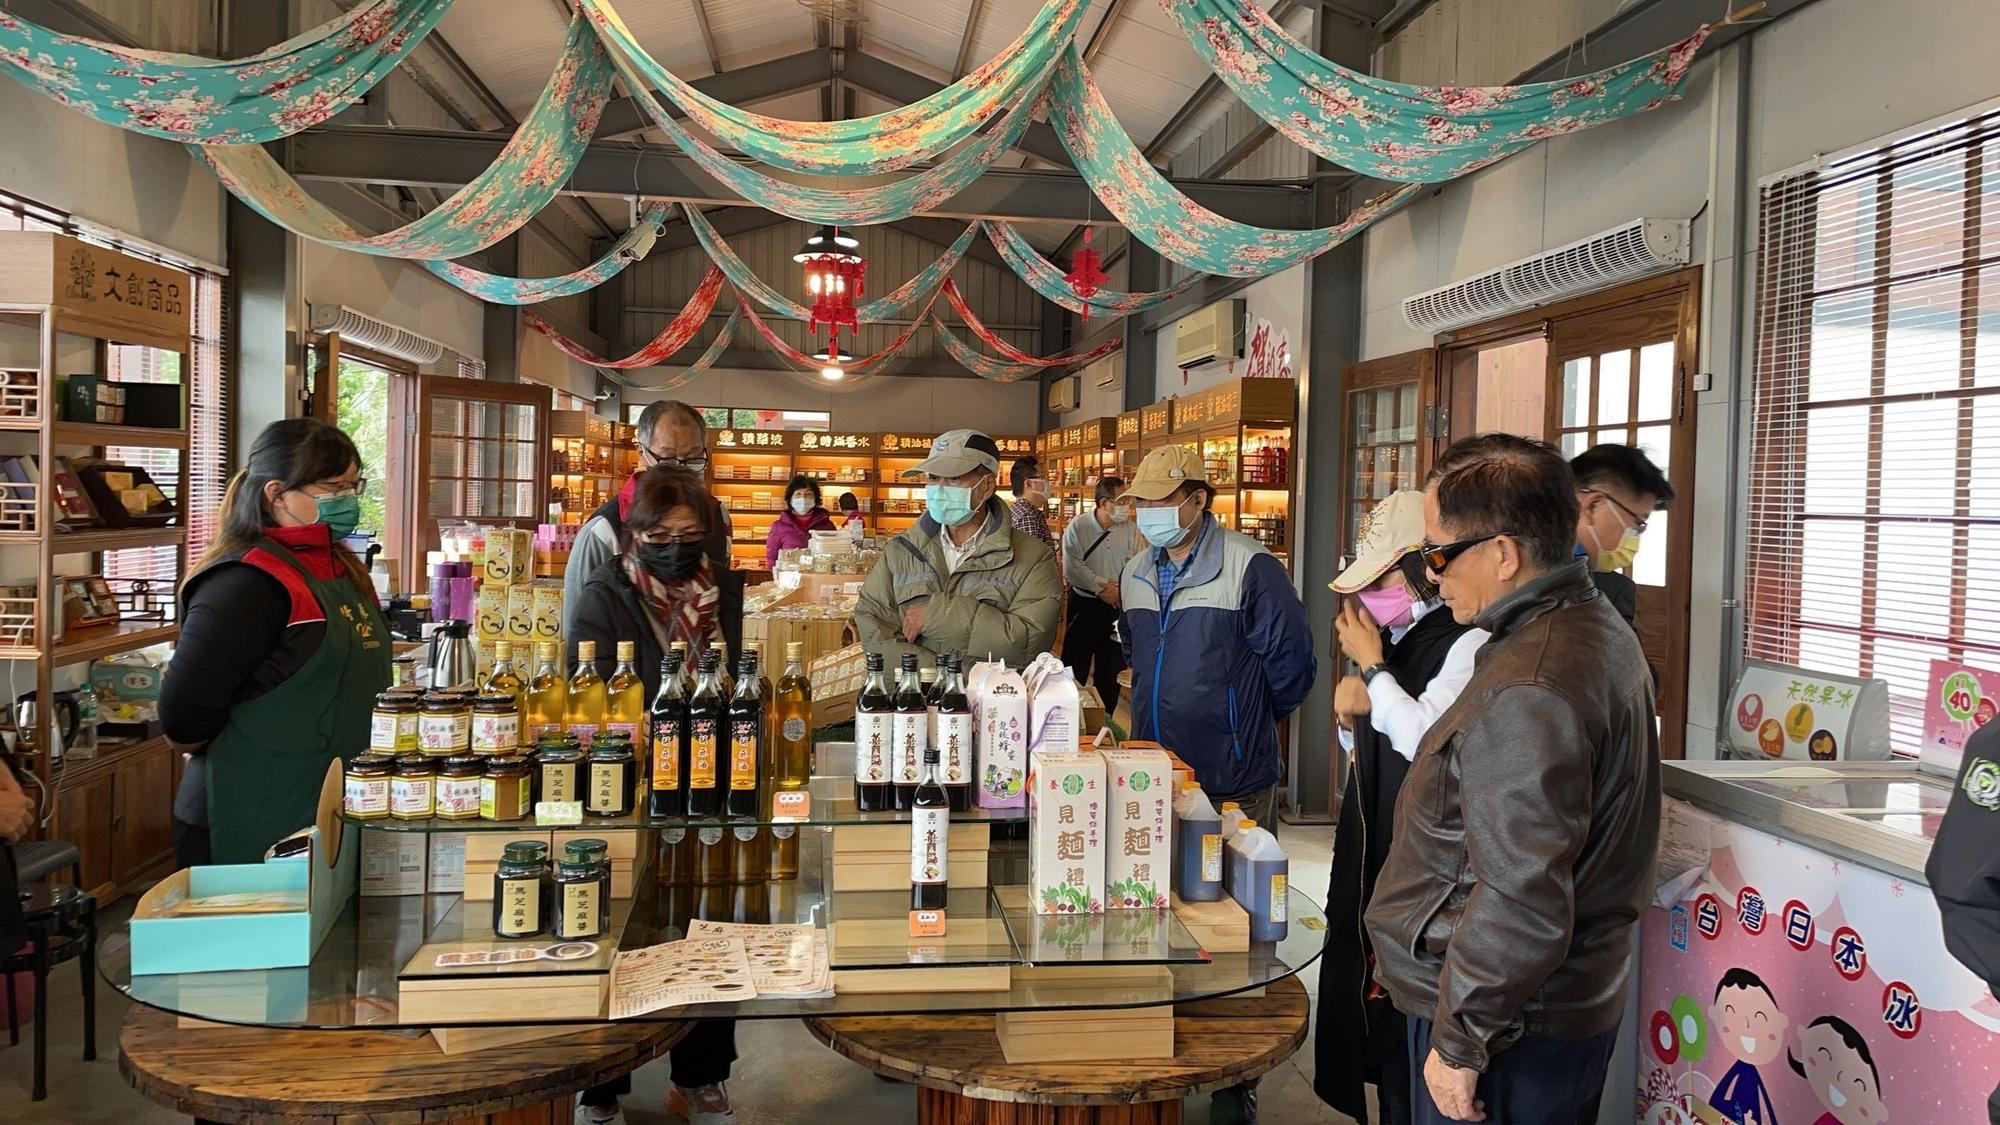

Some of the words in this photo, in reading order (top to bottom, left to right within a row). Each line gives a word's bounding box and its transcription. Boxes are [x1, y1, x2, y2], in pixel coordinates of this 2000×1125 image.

[104, 266, 181, 315] 文創商品
[741, 432, 784, 446] 精華液
[819, 434, 870, 448] 時尚香水
[1949, 690, 1971, 712] 40
[600, 769, 611, 807] 黑芝麻醬
[1088, 780, 1096, 789] 生
[1154, 777, 1163, 786] 生
[1057, 804, 1085, 887] 見麵禮
[1123, 801, 1151, 882] 見麵禮
[513, 886, 527, 928] 黑芝麻醬
[576, 889, 590, 932] 黑芝麻醬
[1697, 892, 1918, 1030] 台灣日本冰
